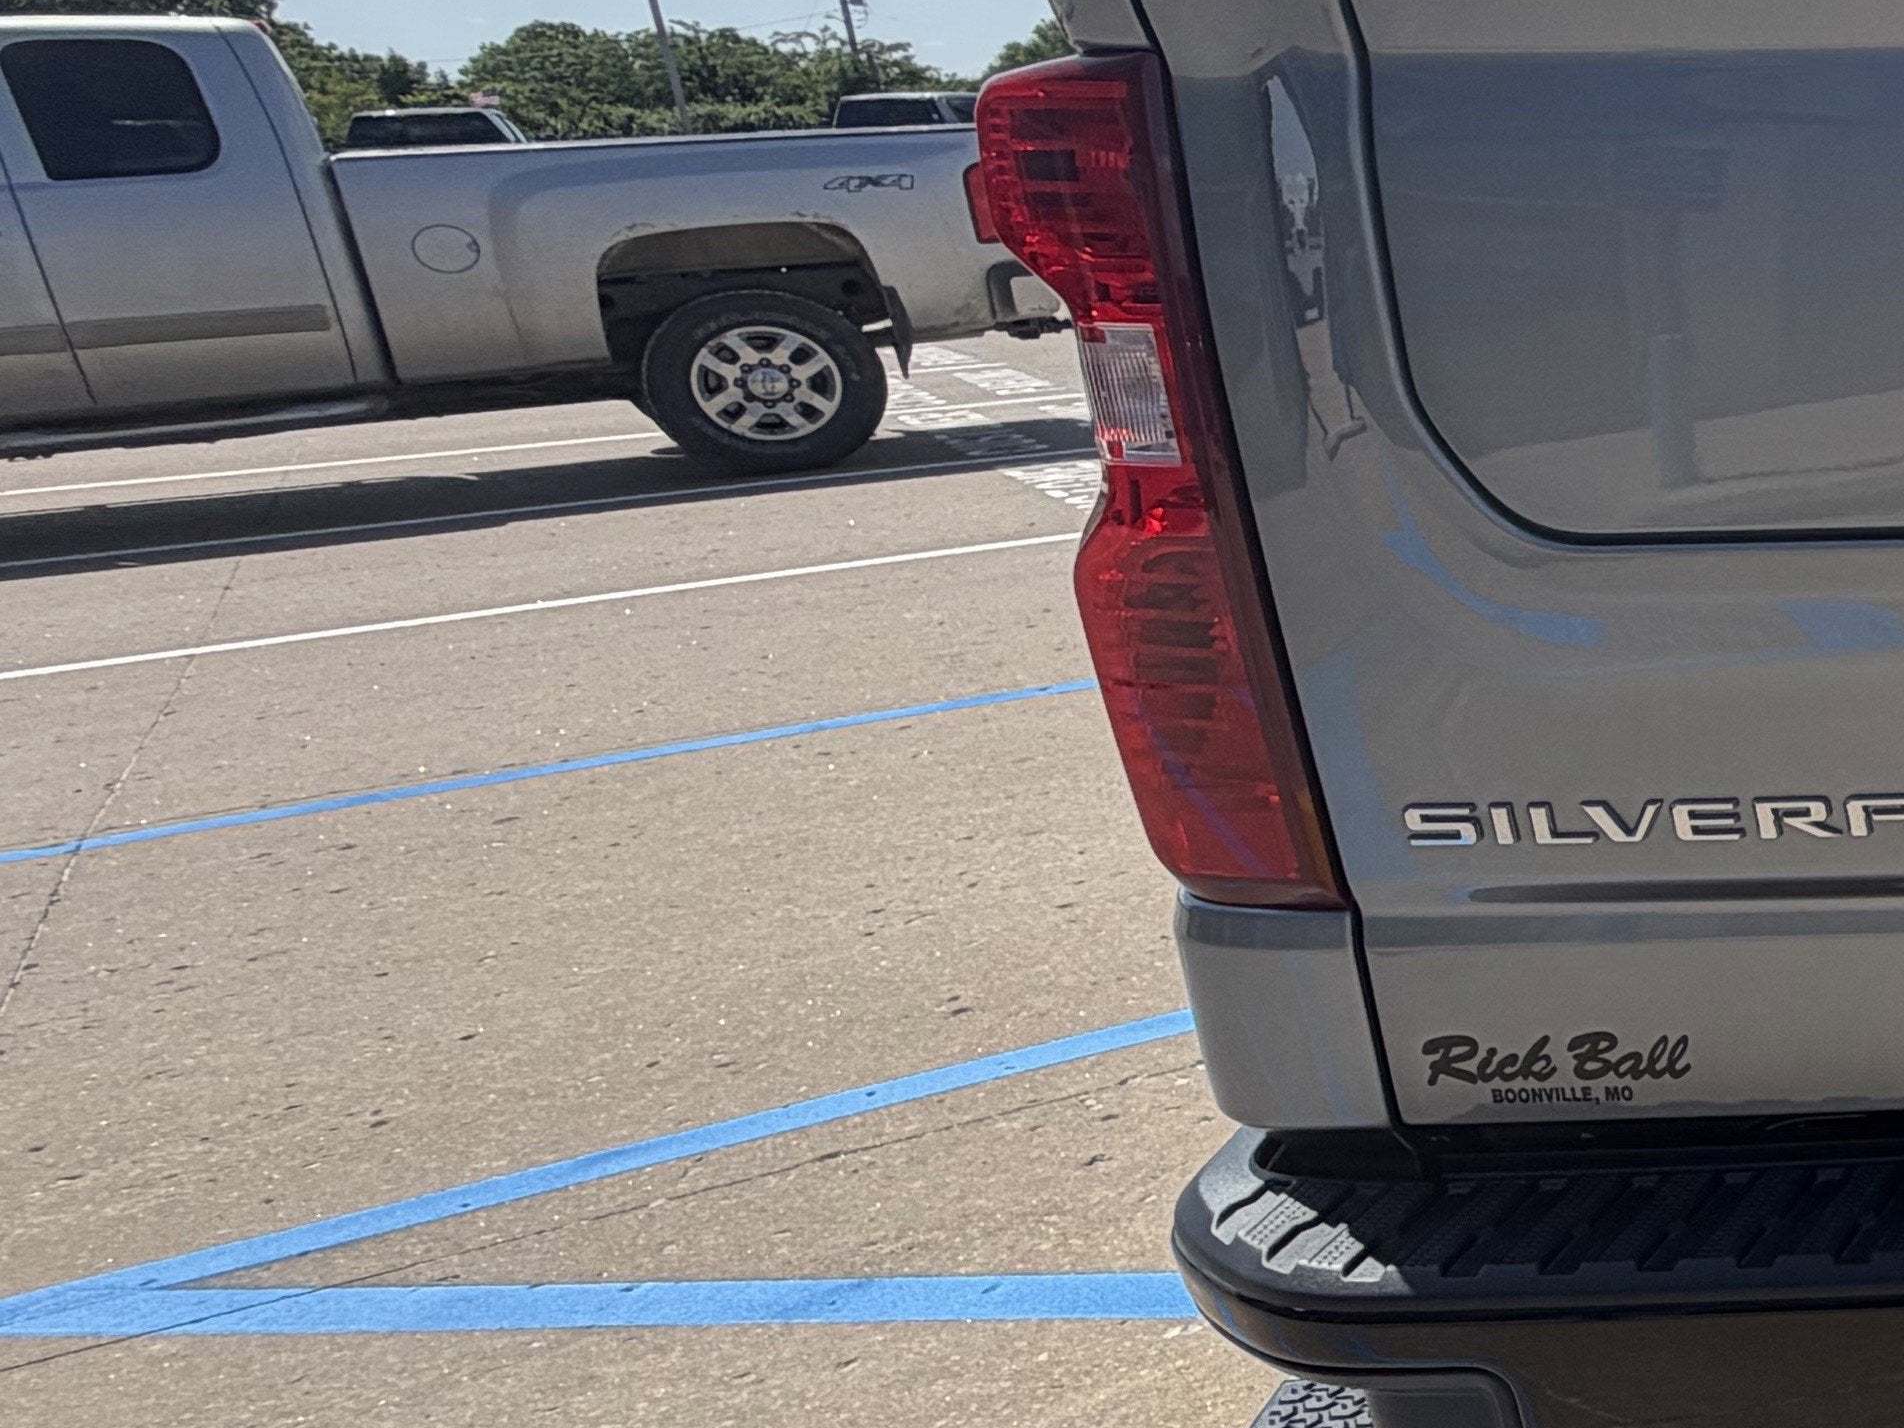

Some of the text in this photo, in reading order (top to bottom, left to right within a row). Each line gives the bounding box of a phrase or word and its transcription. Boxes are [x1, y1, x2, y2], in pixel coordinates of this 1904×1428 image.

[1421, 1031, 1692, 1086] Rick Ball
[1491, 1085, 1634, 1105] BOONVILLE, MO
